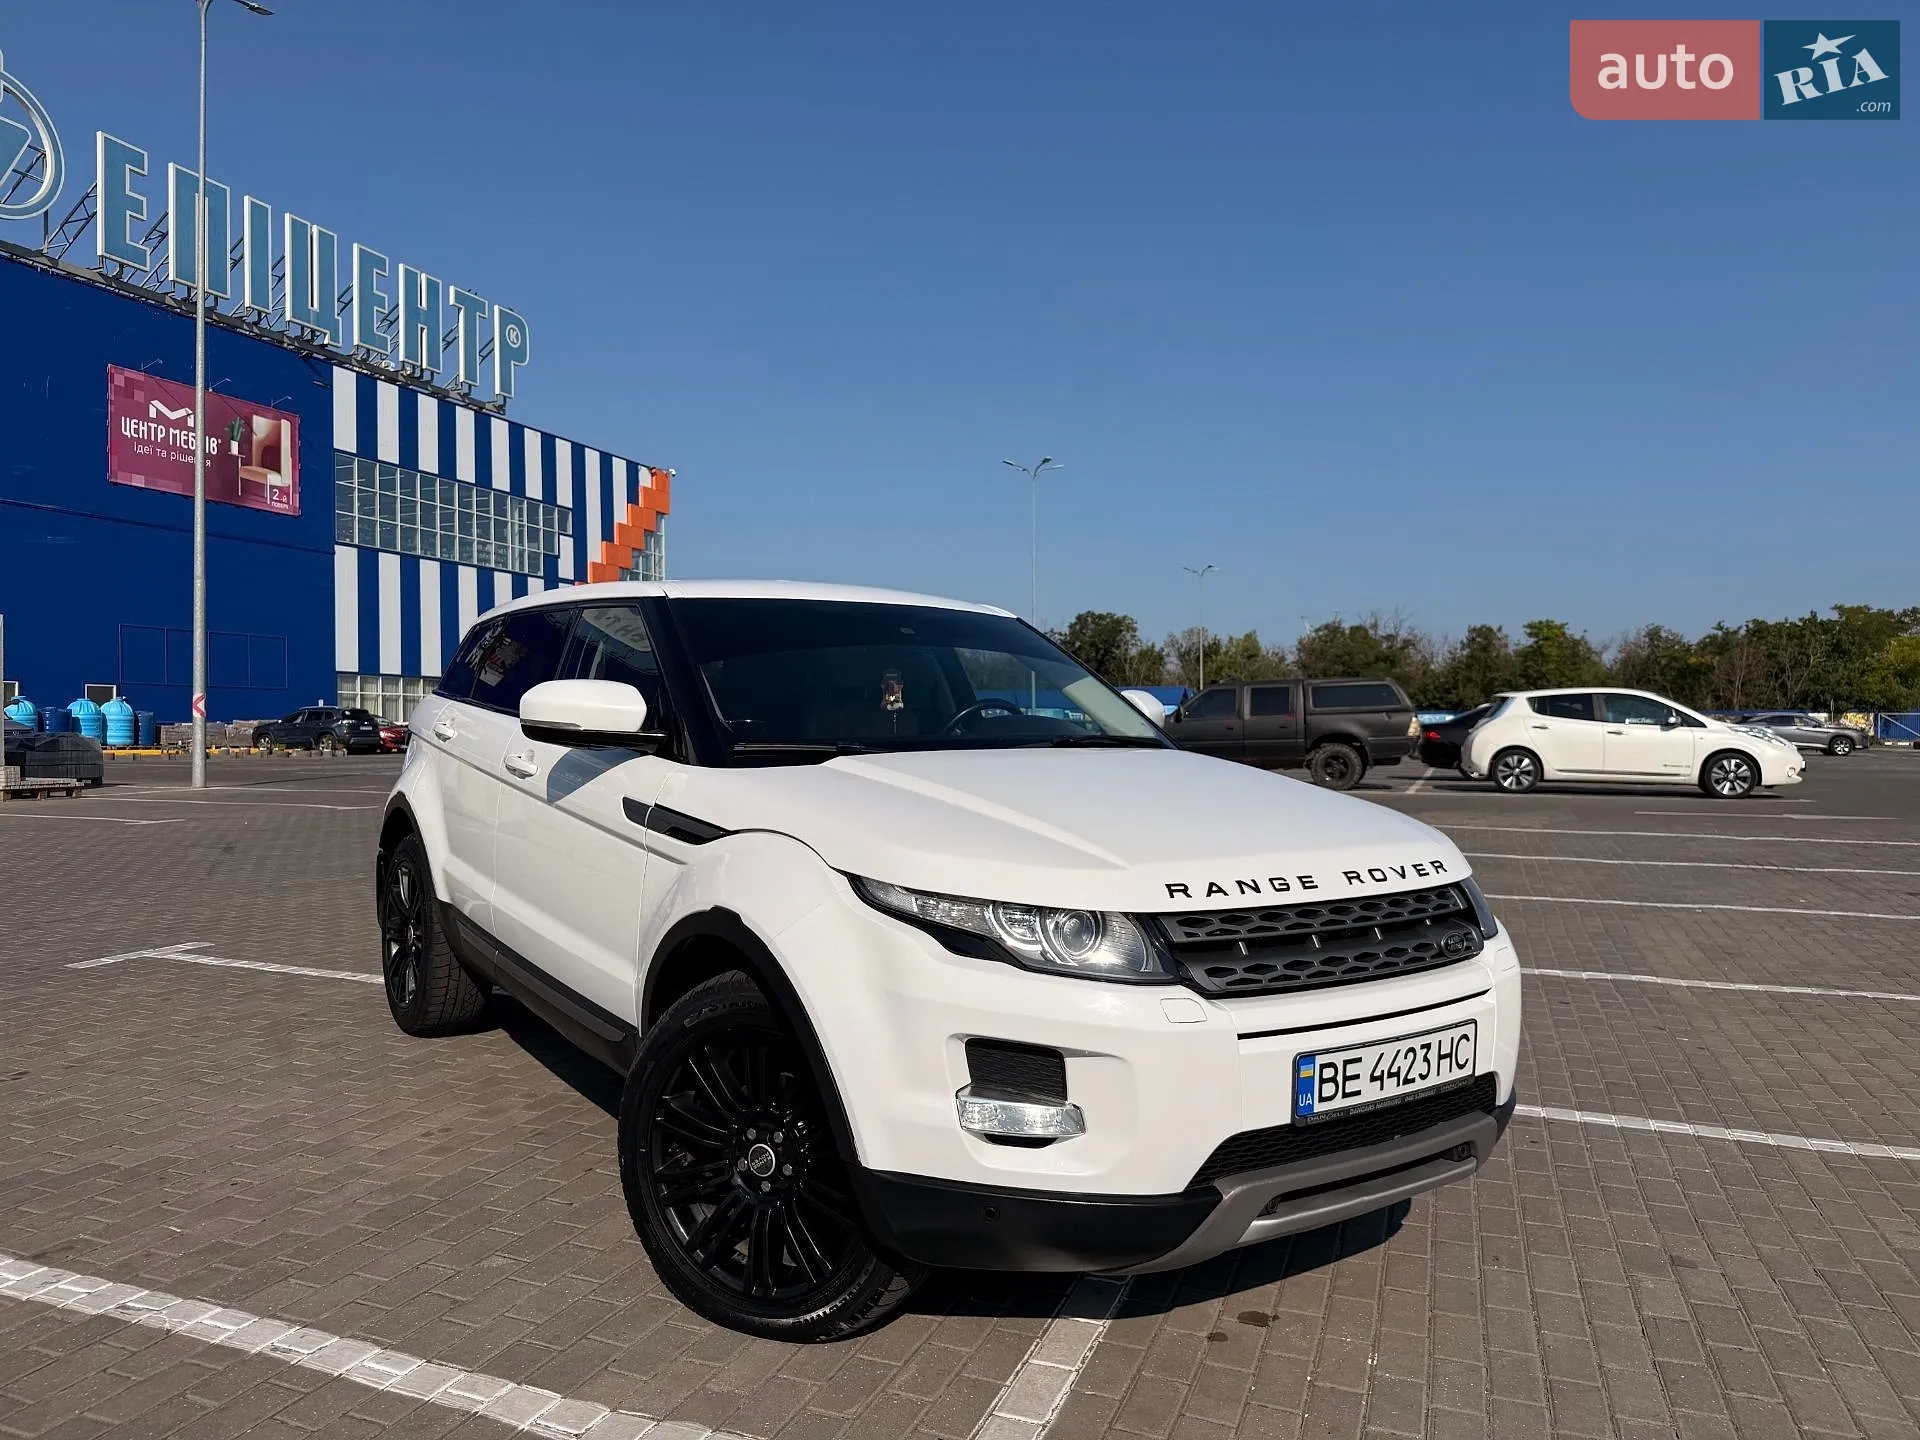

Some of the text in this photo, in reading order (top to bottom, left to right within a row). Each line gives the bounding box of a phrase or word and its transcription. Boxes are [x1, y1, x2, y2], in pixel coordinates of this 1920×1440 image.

[96, 131, 530, 399] ЕПІЦЕНТР
[121, 416, 218, 455] ЦЕНТР МЕБІВ
[156, 448, 167, 458] та
[170, 450, 211, 468] рішея
[1164, 859, 1449, 899] RANGE ROVER
[1317, 1033, 1471, 1104] BE 4423 HC
[1299, 1093, 1313, 1107] UA
